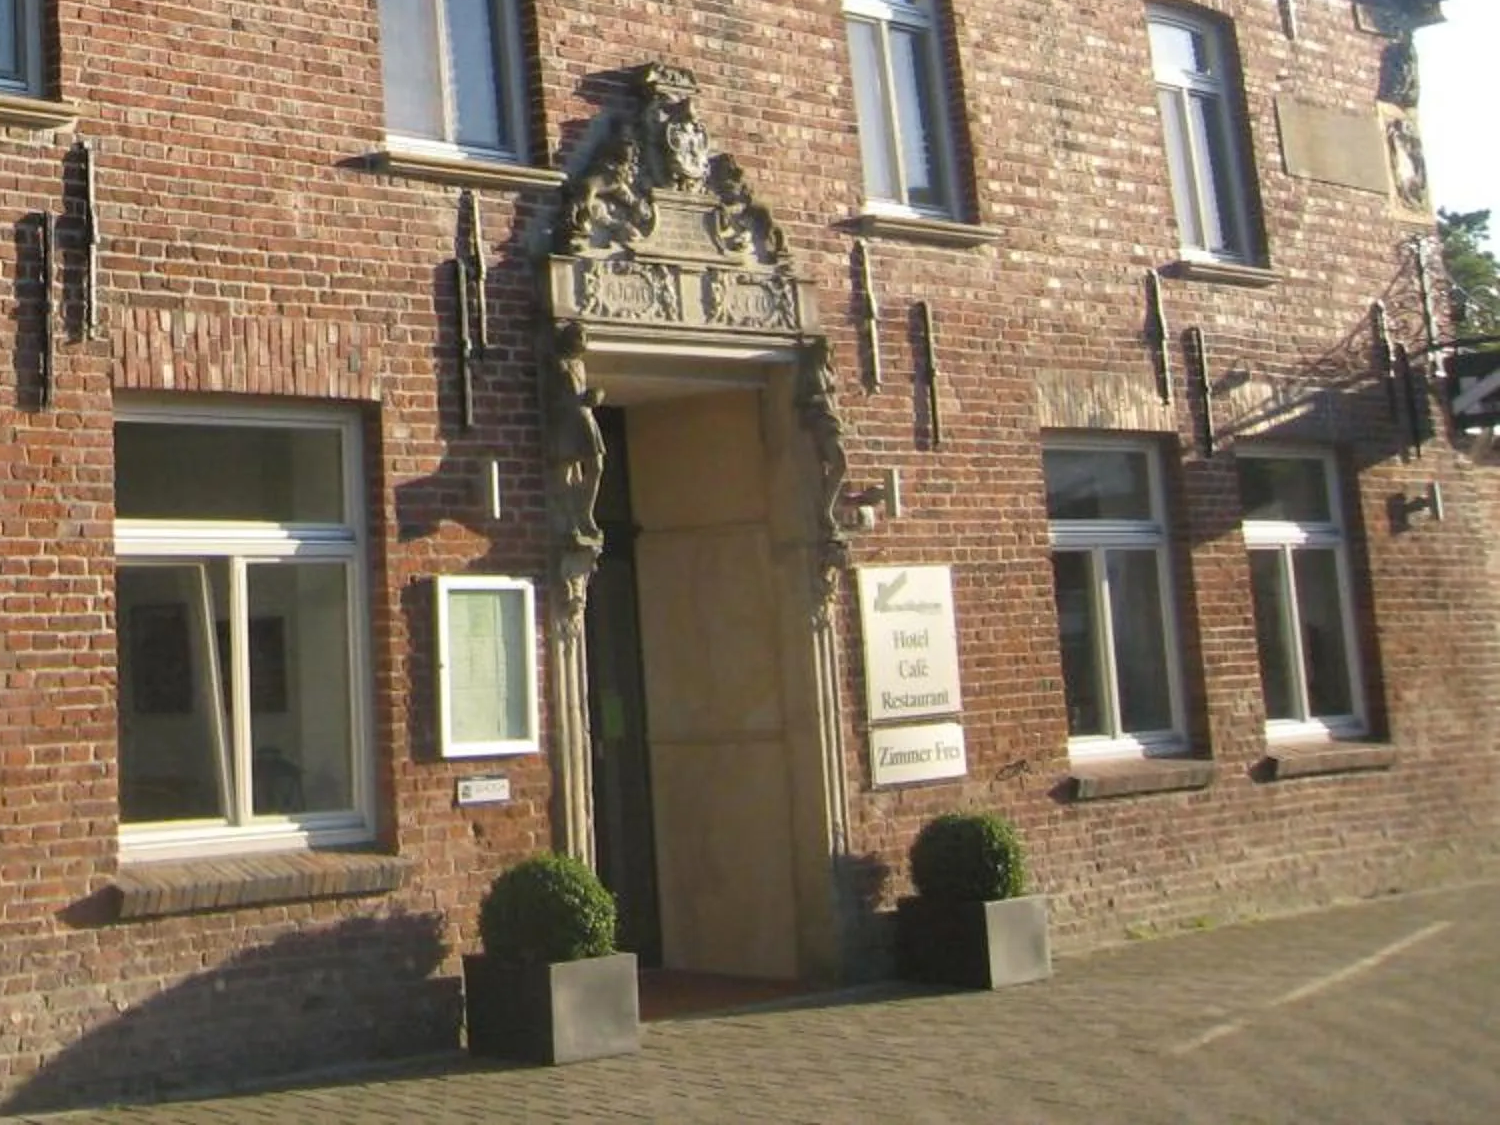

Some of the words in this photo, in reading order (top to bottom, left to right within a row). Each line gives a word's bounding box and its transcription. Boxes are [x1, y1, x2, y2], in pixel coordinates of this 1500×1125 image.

[892, 628, 929, 649] Hotel
[881, 689, 949, 711] Restaurant
[878, 746, 932, 768] Zimmer
